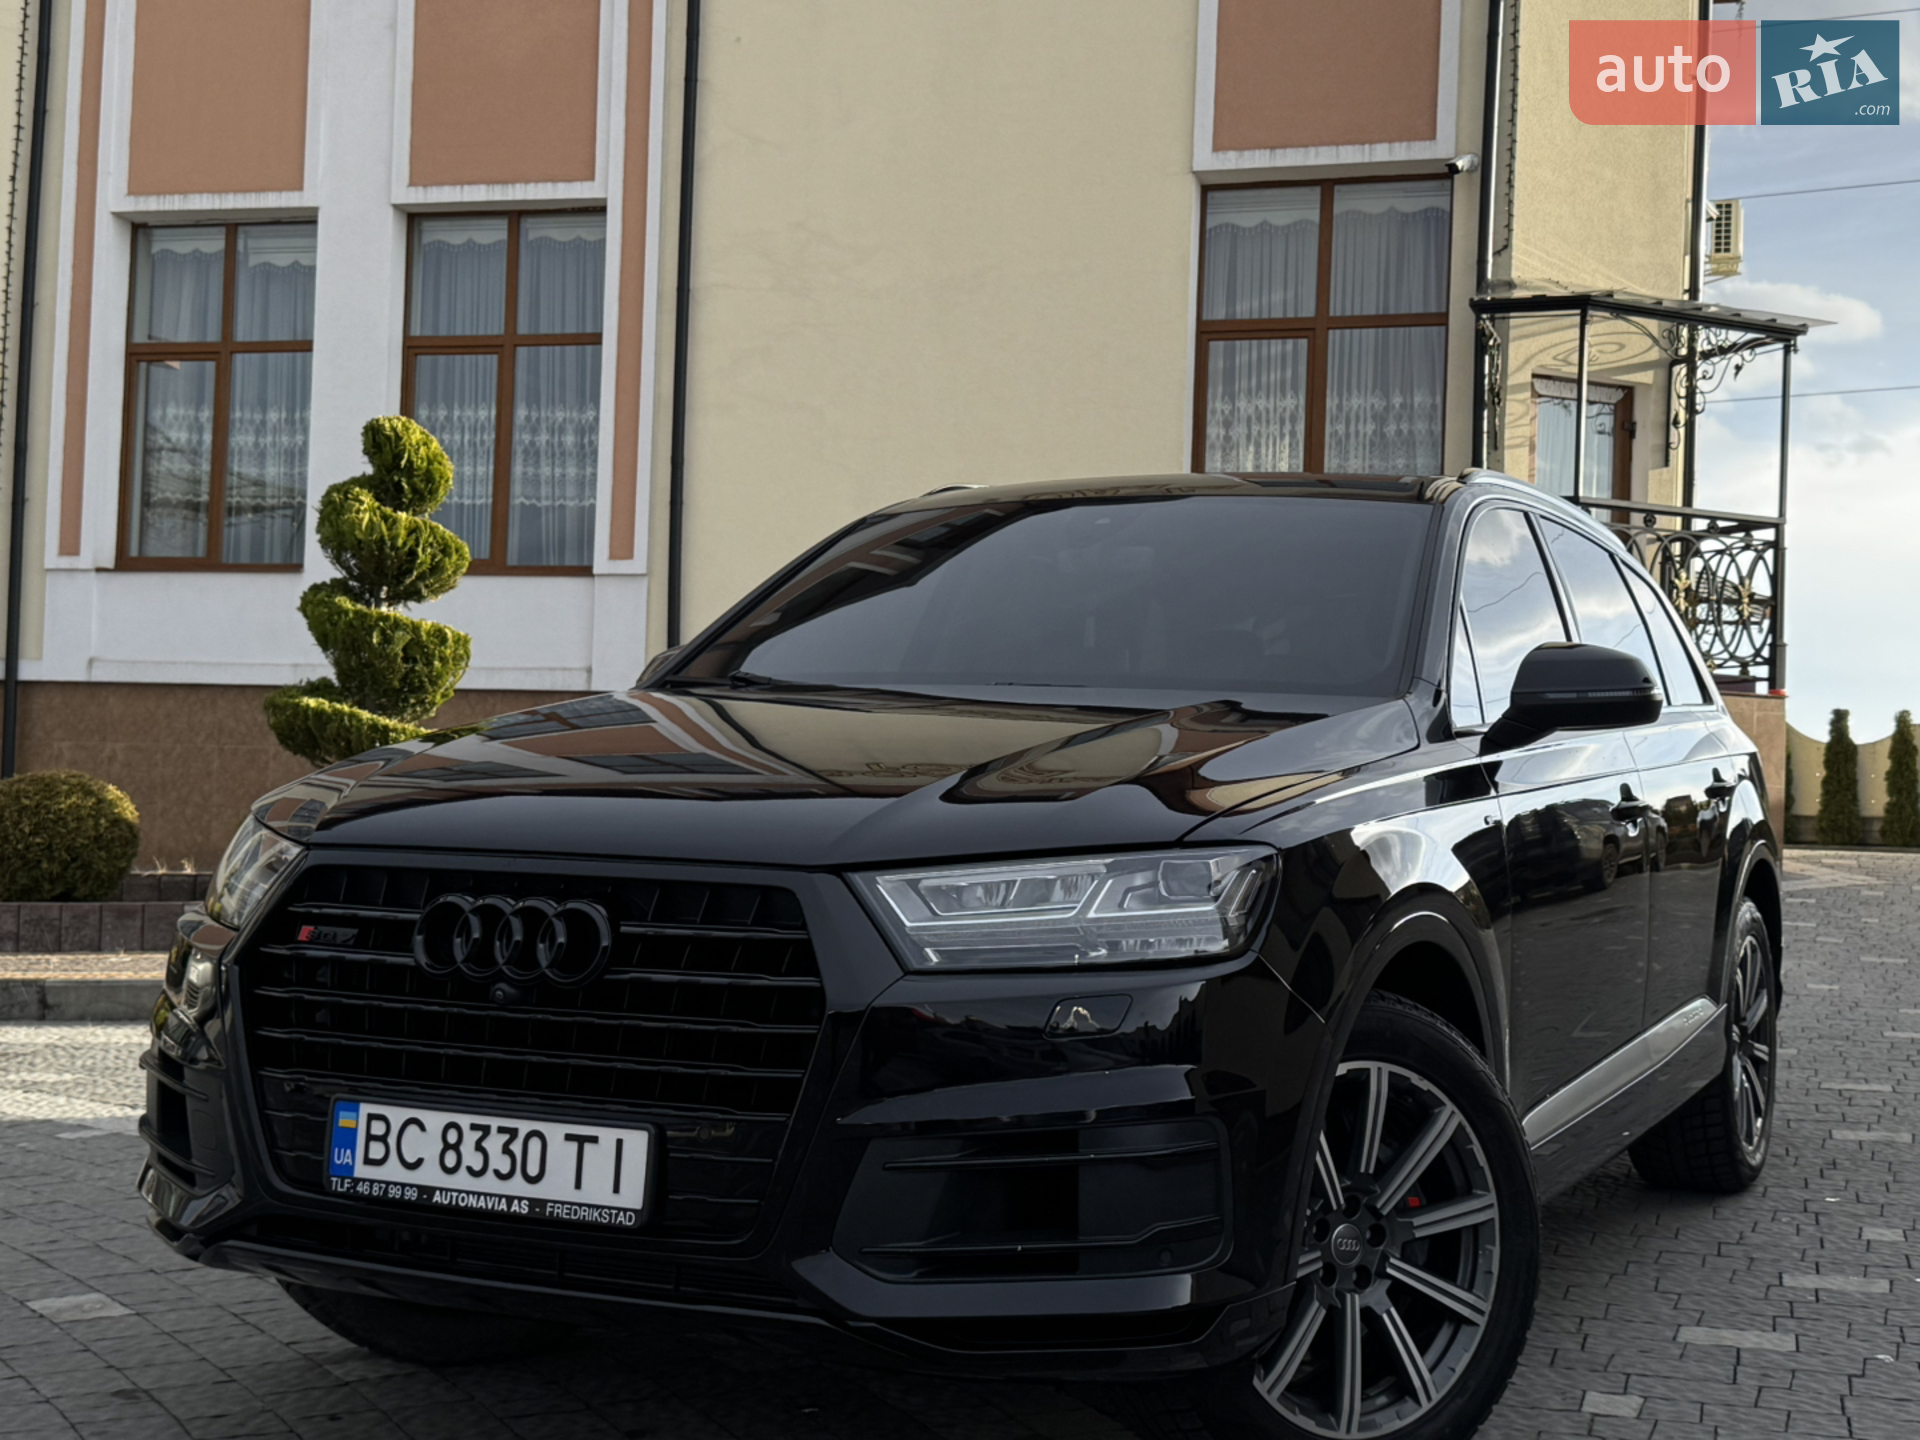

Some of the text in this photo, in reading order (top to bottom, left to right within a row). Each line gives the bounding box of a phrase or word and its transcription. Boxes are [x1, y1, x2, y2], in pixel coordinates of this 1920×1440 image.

[334, 1148, 353, 1166] UA
[363, 1112, 624, 1194] BC 8330 TI
[330, 1177, 354, 1193] TLF:
[356, 1181, 370, 1195] 46
[372, 1182, 386, 1196] 87
[388, 1184, 402, 1199] 99
[404, 1187, 418, 1201] 99
[432, 1190, 507, 1212] AUTONAVIA
[510, 1199, 530, 1215] AS
[546, 1202, 636, 1227] FREDRIKSTAD
